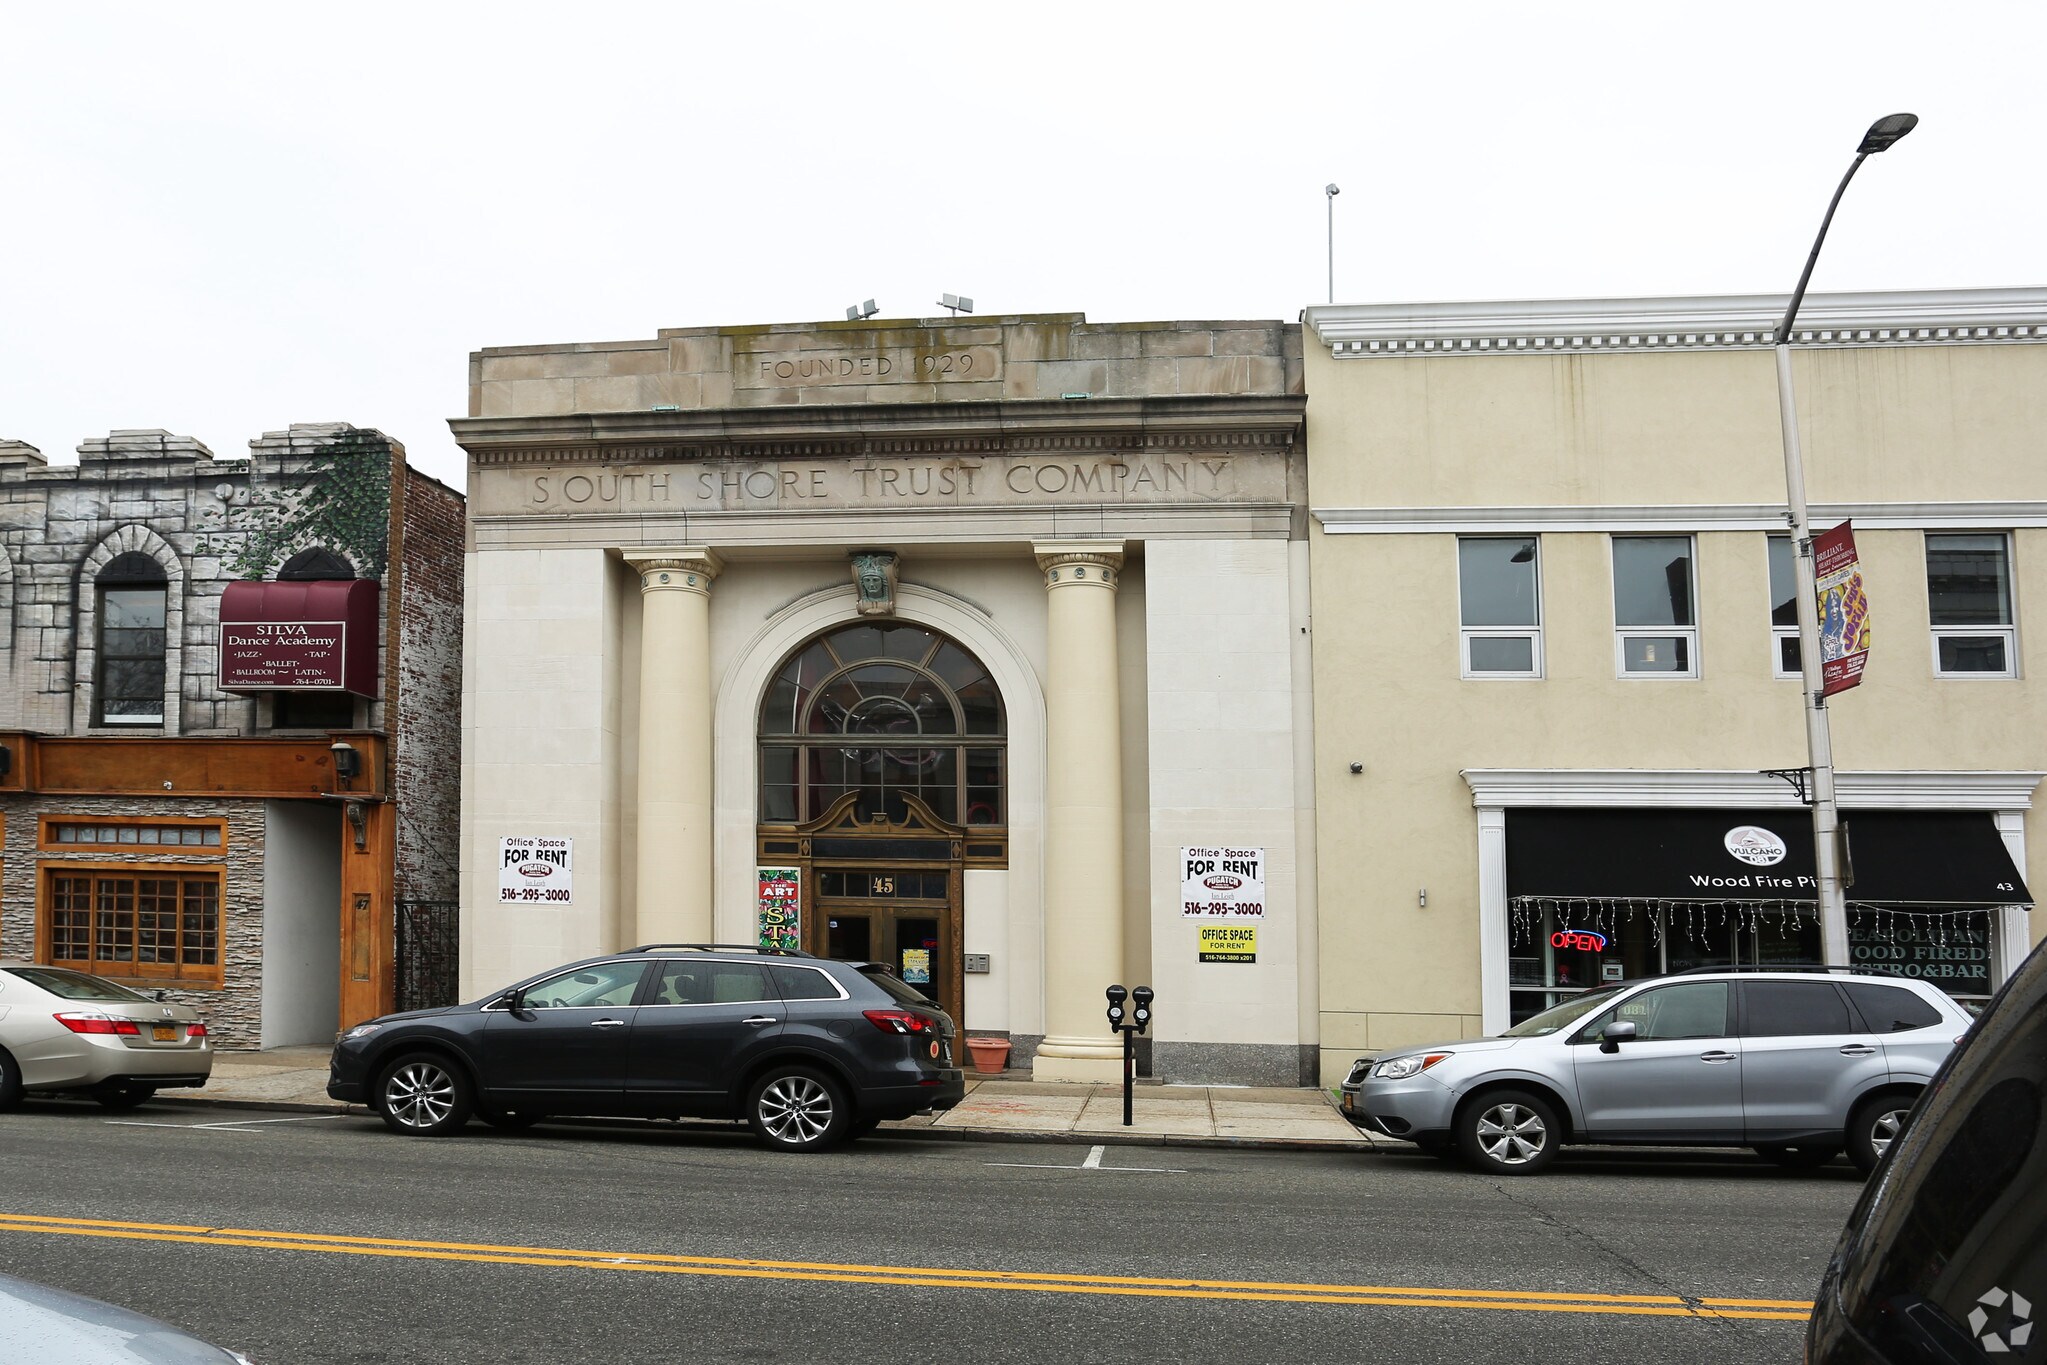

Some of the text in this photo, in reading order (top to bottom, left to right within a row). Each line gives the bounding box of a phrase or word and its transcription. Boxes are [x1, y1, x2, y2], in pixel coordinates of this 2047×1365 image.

[760, 354, 974, 379] FOUNDED 1929
[532, 460, 1229, 503] SOUTH SHORE TRUST COMPANY
[256, 625, 307, 635] SILVA
[228, 636, 336, 648] Dance Academy
[506, 838, 566, 848] Office Space
[505, 849, 567, 868] FOR RENT
[1189, 848, 1256, 859] Office Space
[1187, 860, 1258, 880] FOR RENT
[873, 877, 894, 894] 45
[1207, 876, 1239, 887] PUGATCH
[1689, 875, 1819, 888] Wood Fire Pi
[1996, 882, 2014, 891] 43
[501, 888, 570, 901] 516-295-3000
[763, 887, 795, 896] ART
[356, 899, 369, 910] 47
[1184, 902, 1263, 915] 516-295-3000
[1202, 929, 1253, 940] OFFICE SPACE
[1850, 928, 1984, 943] EAPOLITAN
[1551, 931, 1603, 952] OPEN
[1913, 946, 1986, 960] FIRED
